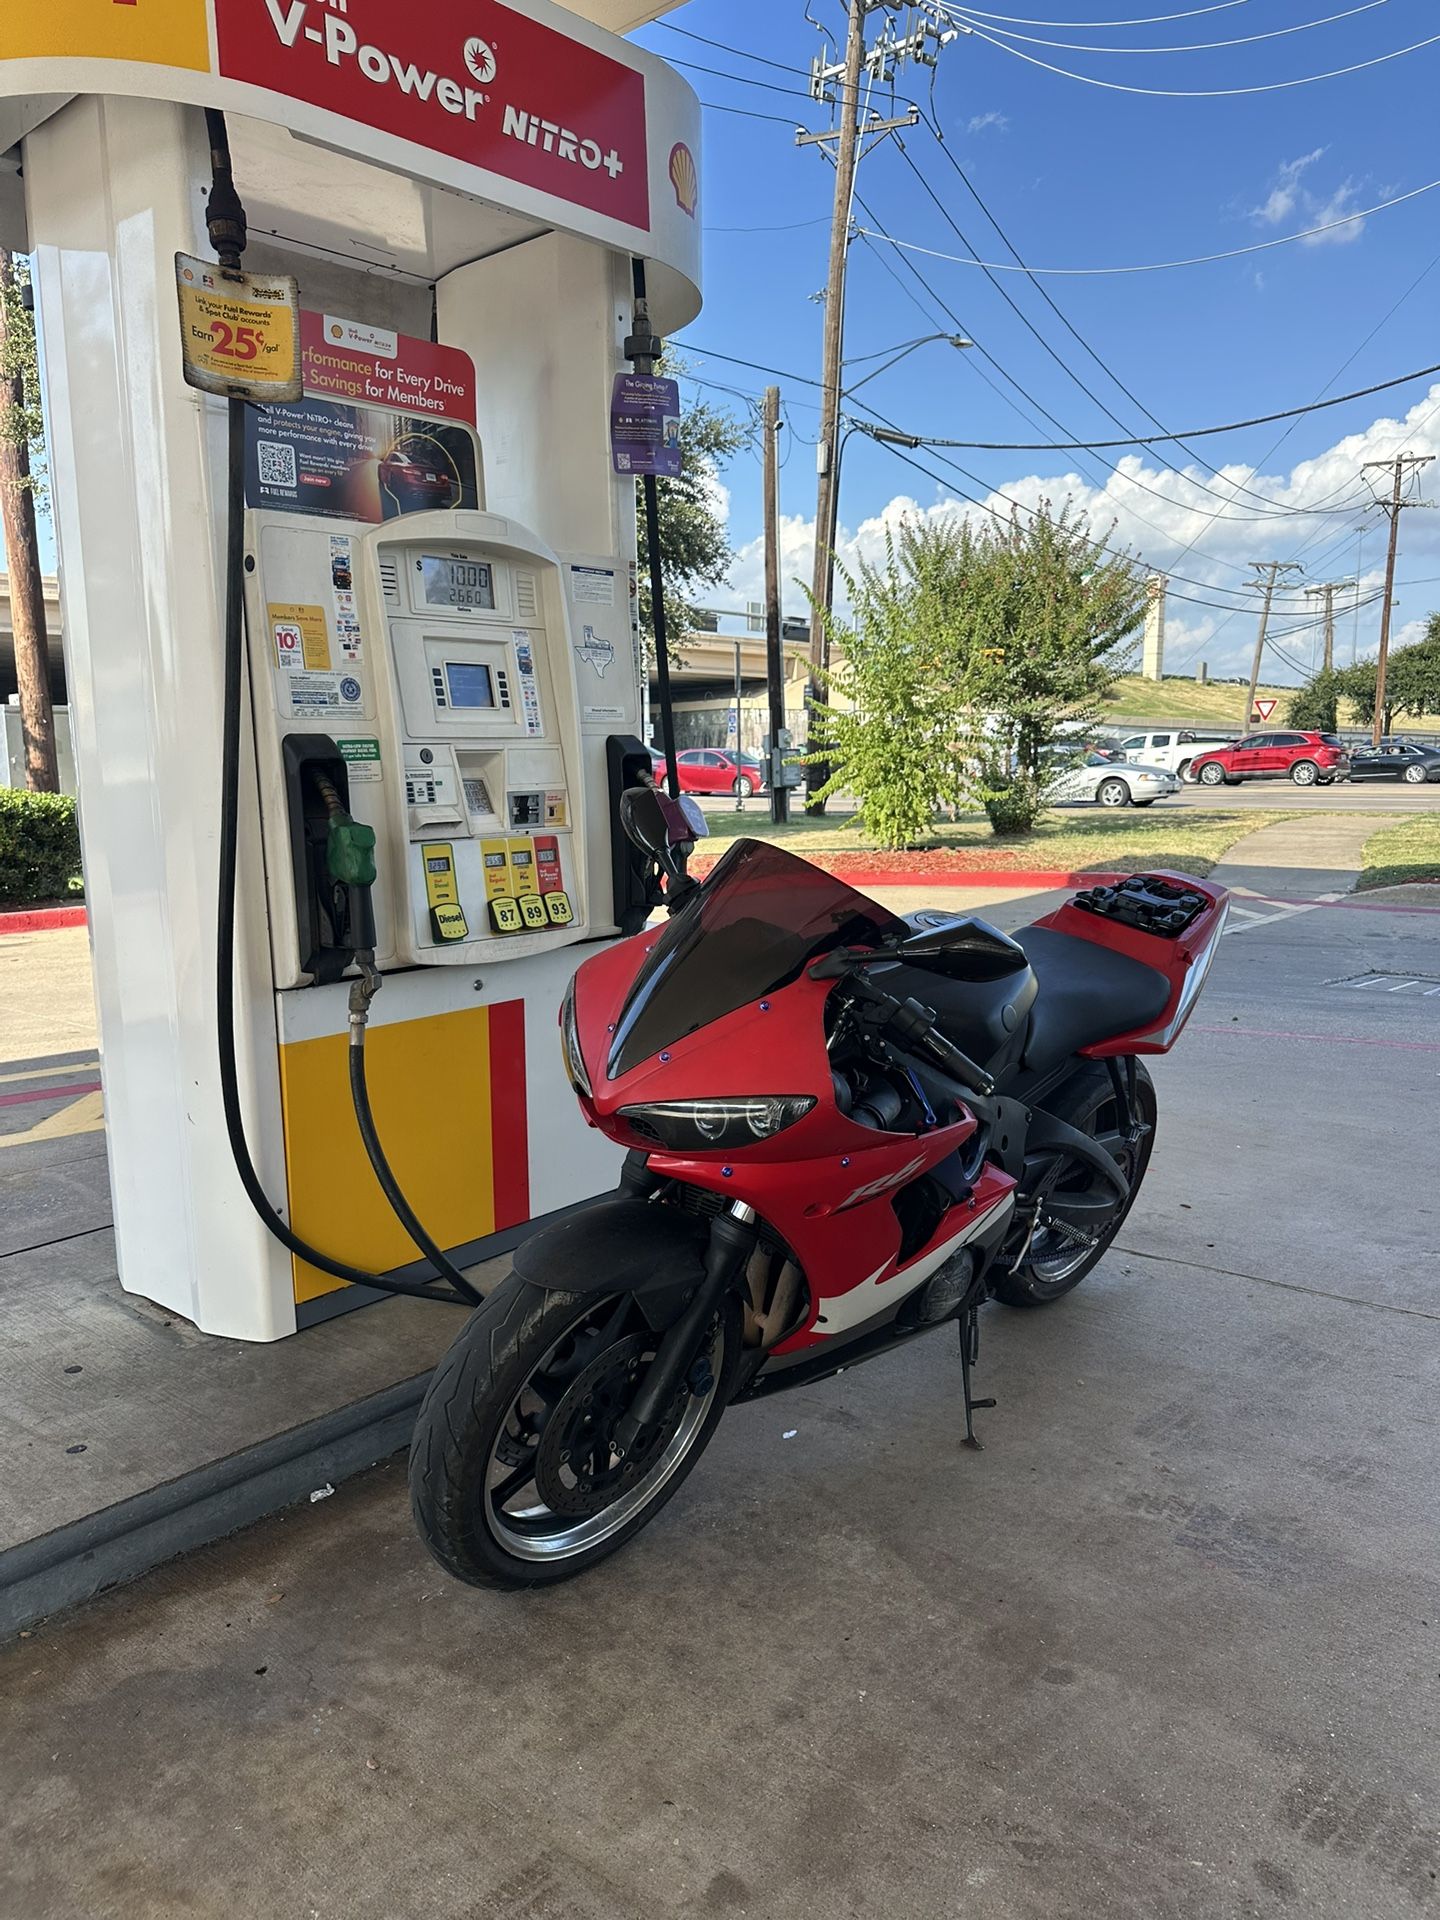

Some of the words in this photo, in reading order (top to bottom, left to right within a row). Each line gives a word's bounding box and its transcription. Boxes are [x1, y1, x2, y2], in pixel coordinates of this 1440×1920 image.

[264, 0, 484, 122] V-Power
[194, 296, 208, 304] Link
[208, 300, 222, 310] your
[224, 304, 238, 313] Fuel
[239, 308, 272, 318] Rewards
[205, 307, 221, 318] Spot
[222, 311, 238, 321] Club
[240, 317, 270, 326] accounts
[192, 325, 214, 342] Earn
[302, 346, 372, 376] rformance
[375, 361, 394, 380] for
[397, 368, 431, 393] Every
[434, 376, 465, 396] Drive
[310, 369, 362, 396] Savings
[365, 379, 384, 398] for
[387, 385, 445, 411] Members
[275, 407, 304, 419] V-Power
[334, 419, 354, 429] cleans
[258, 416, 272, 424] and
[273, 419, 301, 429] protects
[302, 424, 317, 433] your
[344, 430, 363, 441] giving
[364, 435, 376, 443] you
[258, 426, 277, 435] more
[278, 429, 322, 443] performance
[323, 437, 338, 446] with
[338, 441, 357, 450] every
[270, 488, 280, 496] FUEL
[416, 560, 422, 571] $
[439, 912, 463, 923] Diesel
[500, 909, 514, 922] 87
[527, 906, 542, 919] 89
[552, 903, 567, 915] 93
